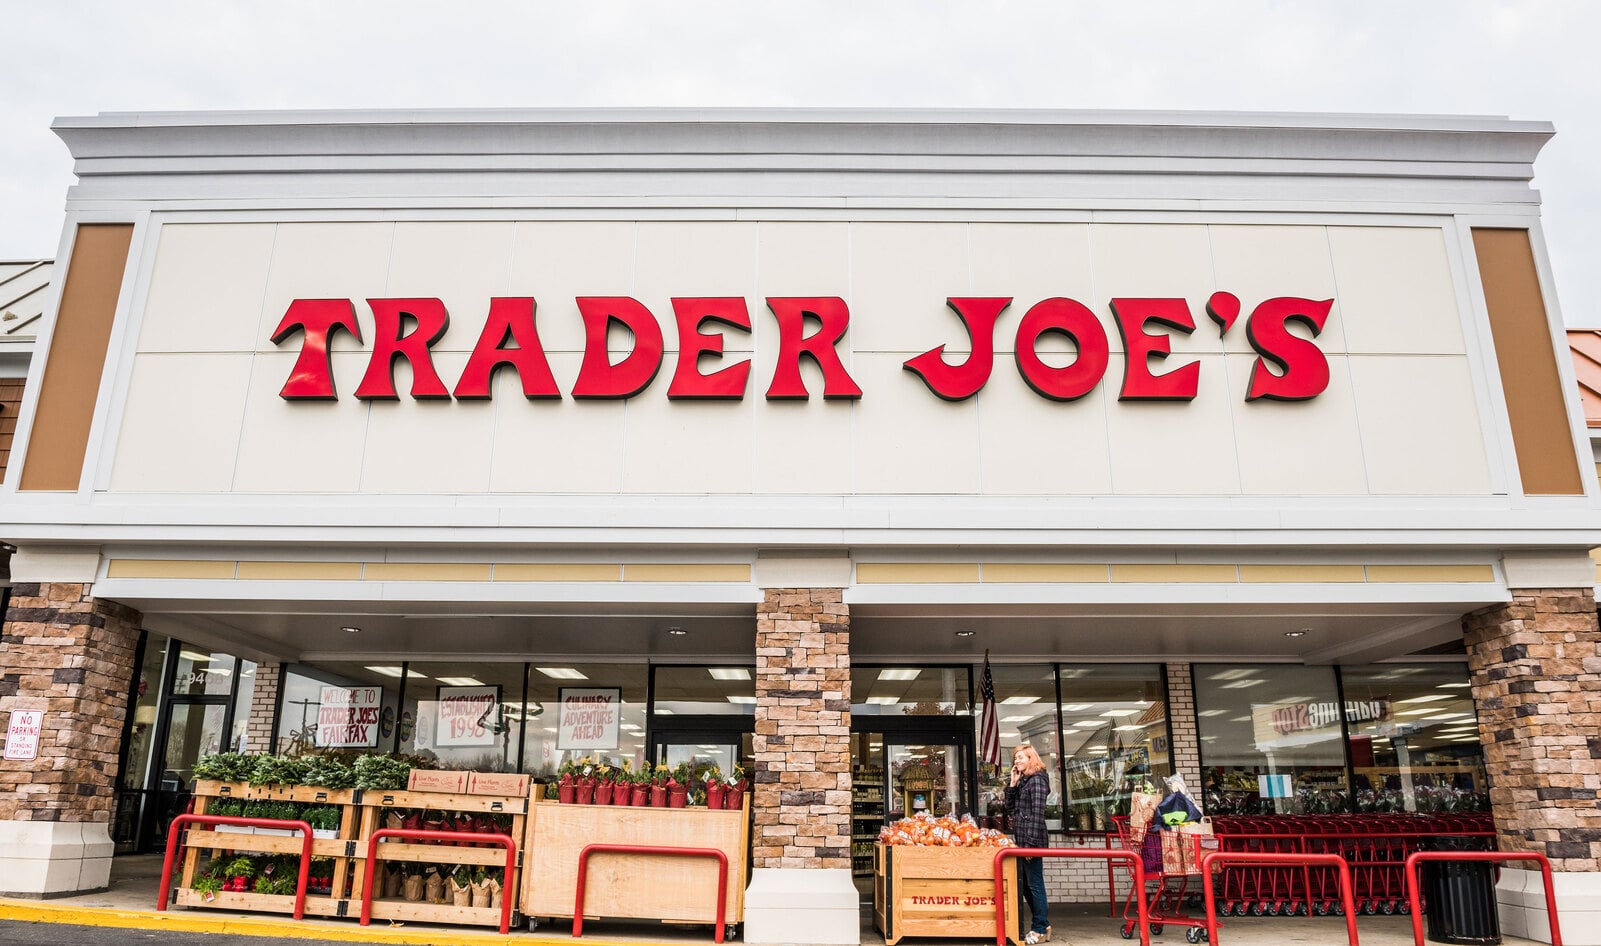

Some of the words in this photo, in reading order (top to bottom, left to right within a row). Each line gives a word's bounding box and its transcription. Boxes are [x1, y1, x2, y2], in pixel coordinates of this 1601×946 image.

[270, 296, 863, 402] TRADER
[903, 291, 1335, 402] JOE'S
[323, 689, 361, 704] WELCOME
[364, 689, 376, 703] TO
[564, 695, 612, 710] CULINARY
[20, 715, 33, 725] NO
[320, 706, 356, 725] TRADER
[356, 706, 378, 725] JOES
[563, 710, 613, 726] ADVENTURE
[11, 726, 38, 736] PARKING
[322, 725, 369, 743] FAIRFAX
[571, 725, 604, 741] AHEAD
[912, 896, 960, 905] TRADER
[963, 896, 996, 906] JOE'S
